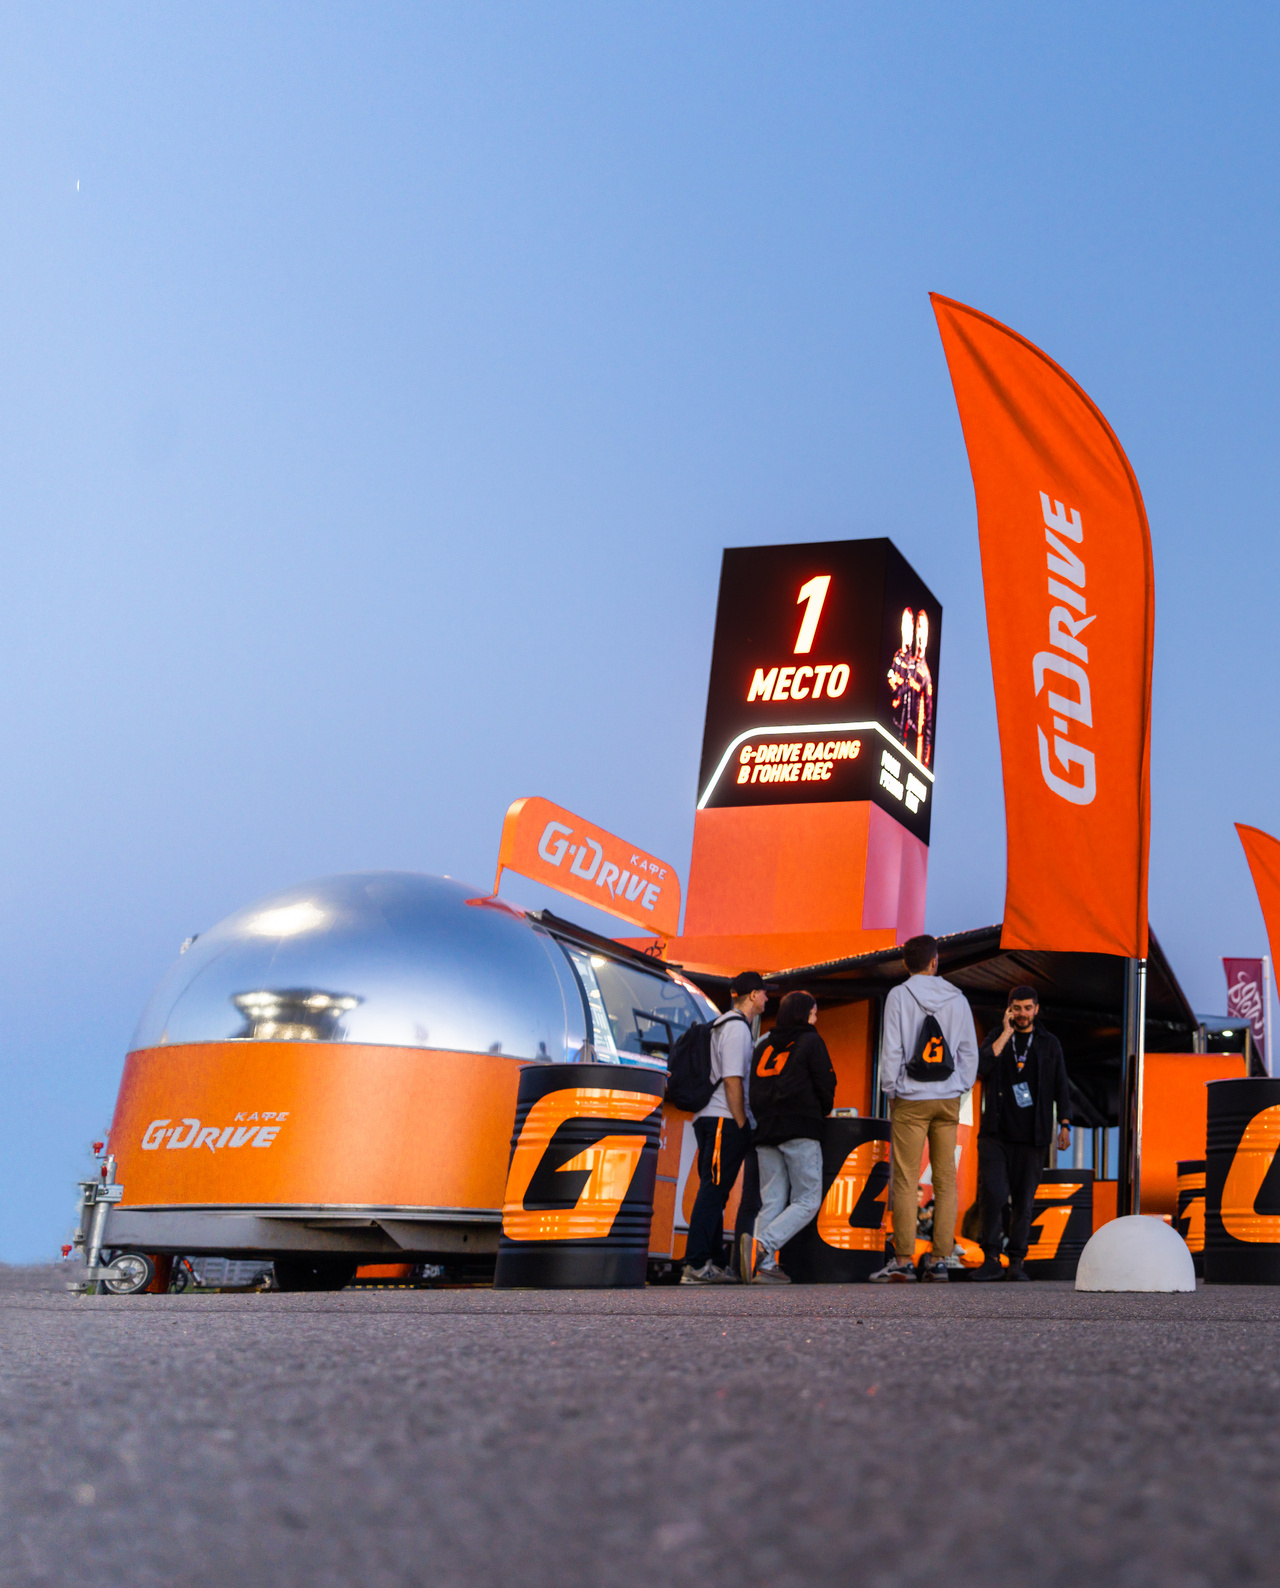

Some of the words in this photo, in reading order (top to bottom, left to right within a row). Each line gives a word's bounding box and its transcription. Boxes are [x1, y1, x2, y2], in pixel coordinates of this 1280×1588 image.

[794, 575, 831, 654] 1
[747, 664, 850, 702] МЕСТО
[740, 743, 803, 764] G-DRIVE
[801, 740, 861, 761] RACING
[750, 763, 802, 783] ГОНКЕ
[801, 761, 833, 781] REC
[630, 854, 667, 880] КАФЕ
[922, 1036, 944, 1064] G
[234, 1111, 290, 1122] КАФЕ
[502, 1087, 663, 1241] G
